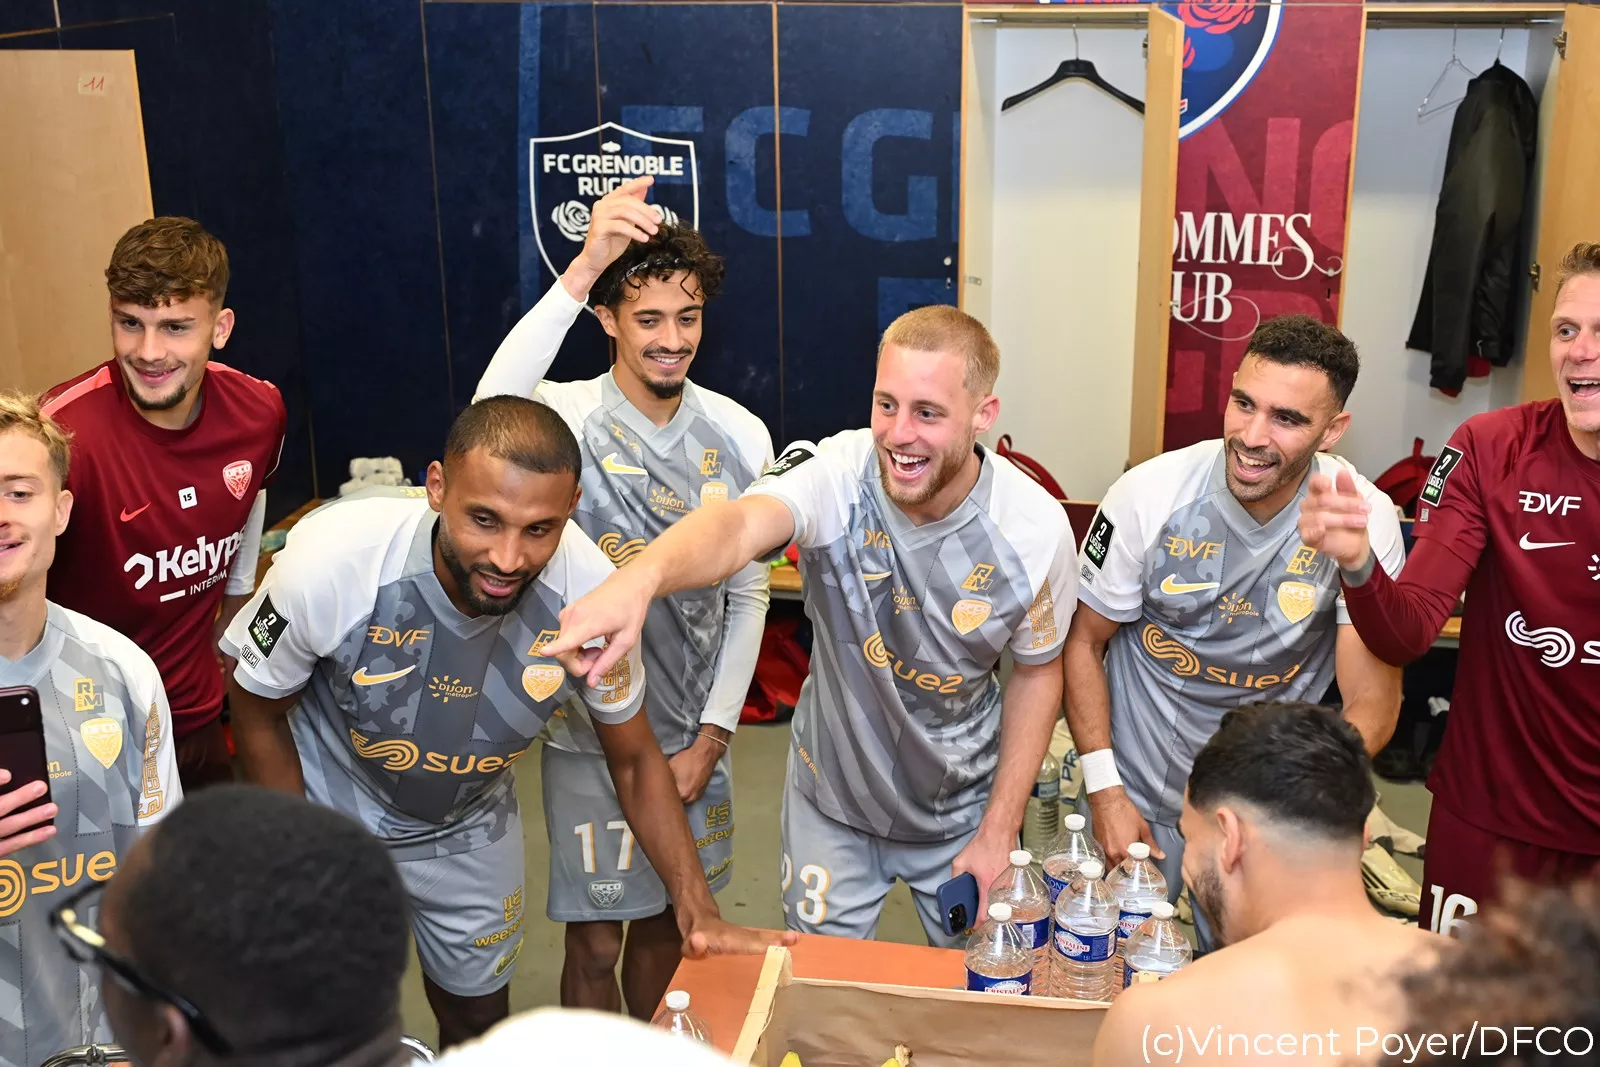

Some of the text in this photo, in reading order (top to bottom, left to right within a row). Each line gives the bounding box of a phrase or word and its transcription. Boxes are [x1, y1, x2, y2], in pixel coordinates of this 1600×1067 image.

[543, 154, 684, 176] FC GRENOBLE
[578, 177, 636, 196] RUG
[183, 494, 192, 502] 15
[1518, 490, 1582, 516] DVF
[1164, 535, 1223, 561] DVF
[190, 569, 228, 595] INTERIM
[368, 625, 430, 648] DVF
[574, 821, 636, 873] 17
[31, 851, 117, 895] sue
